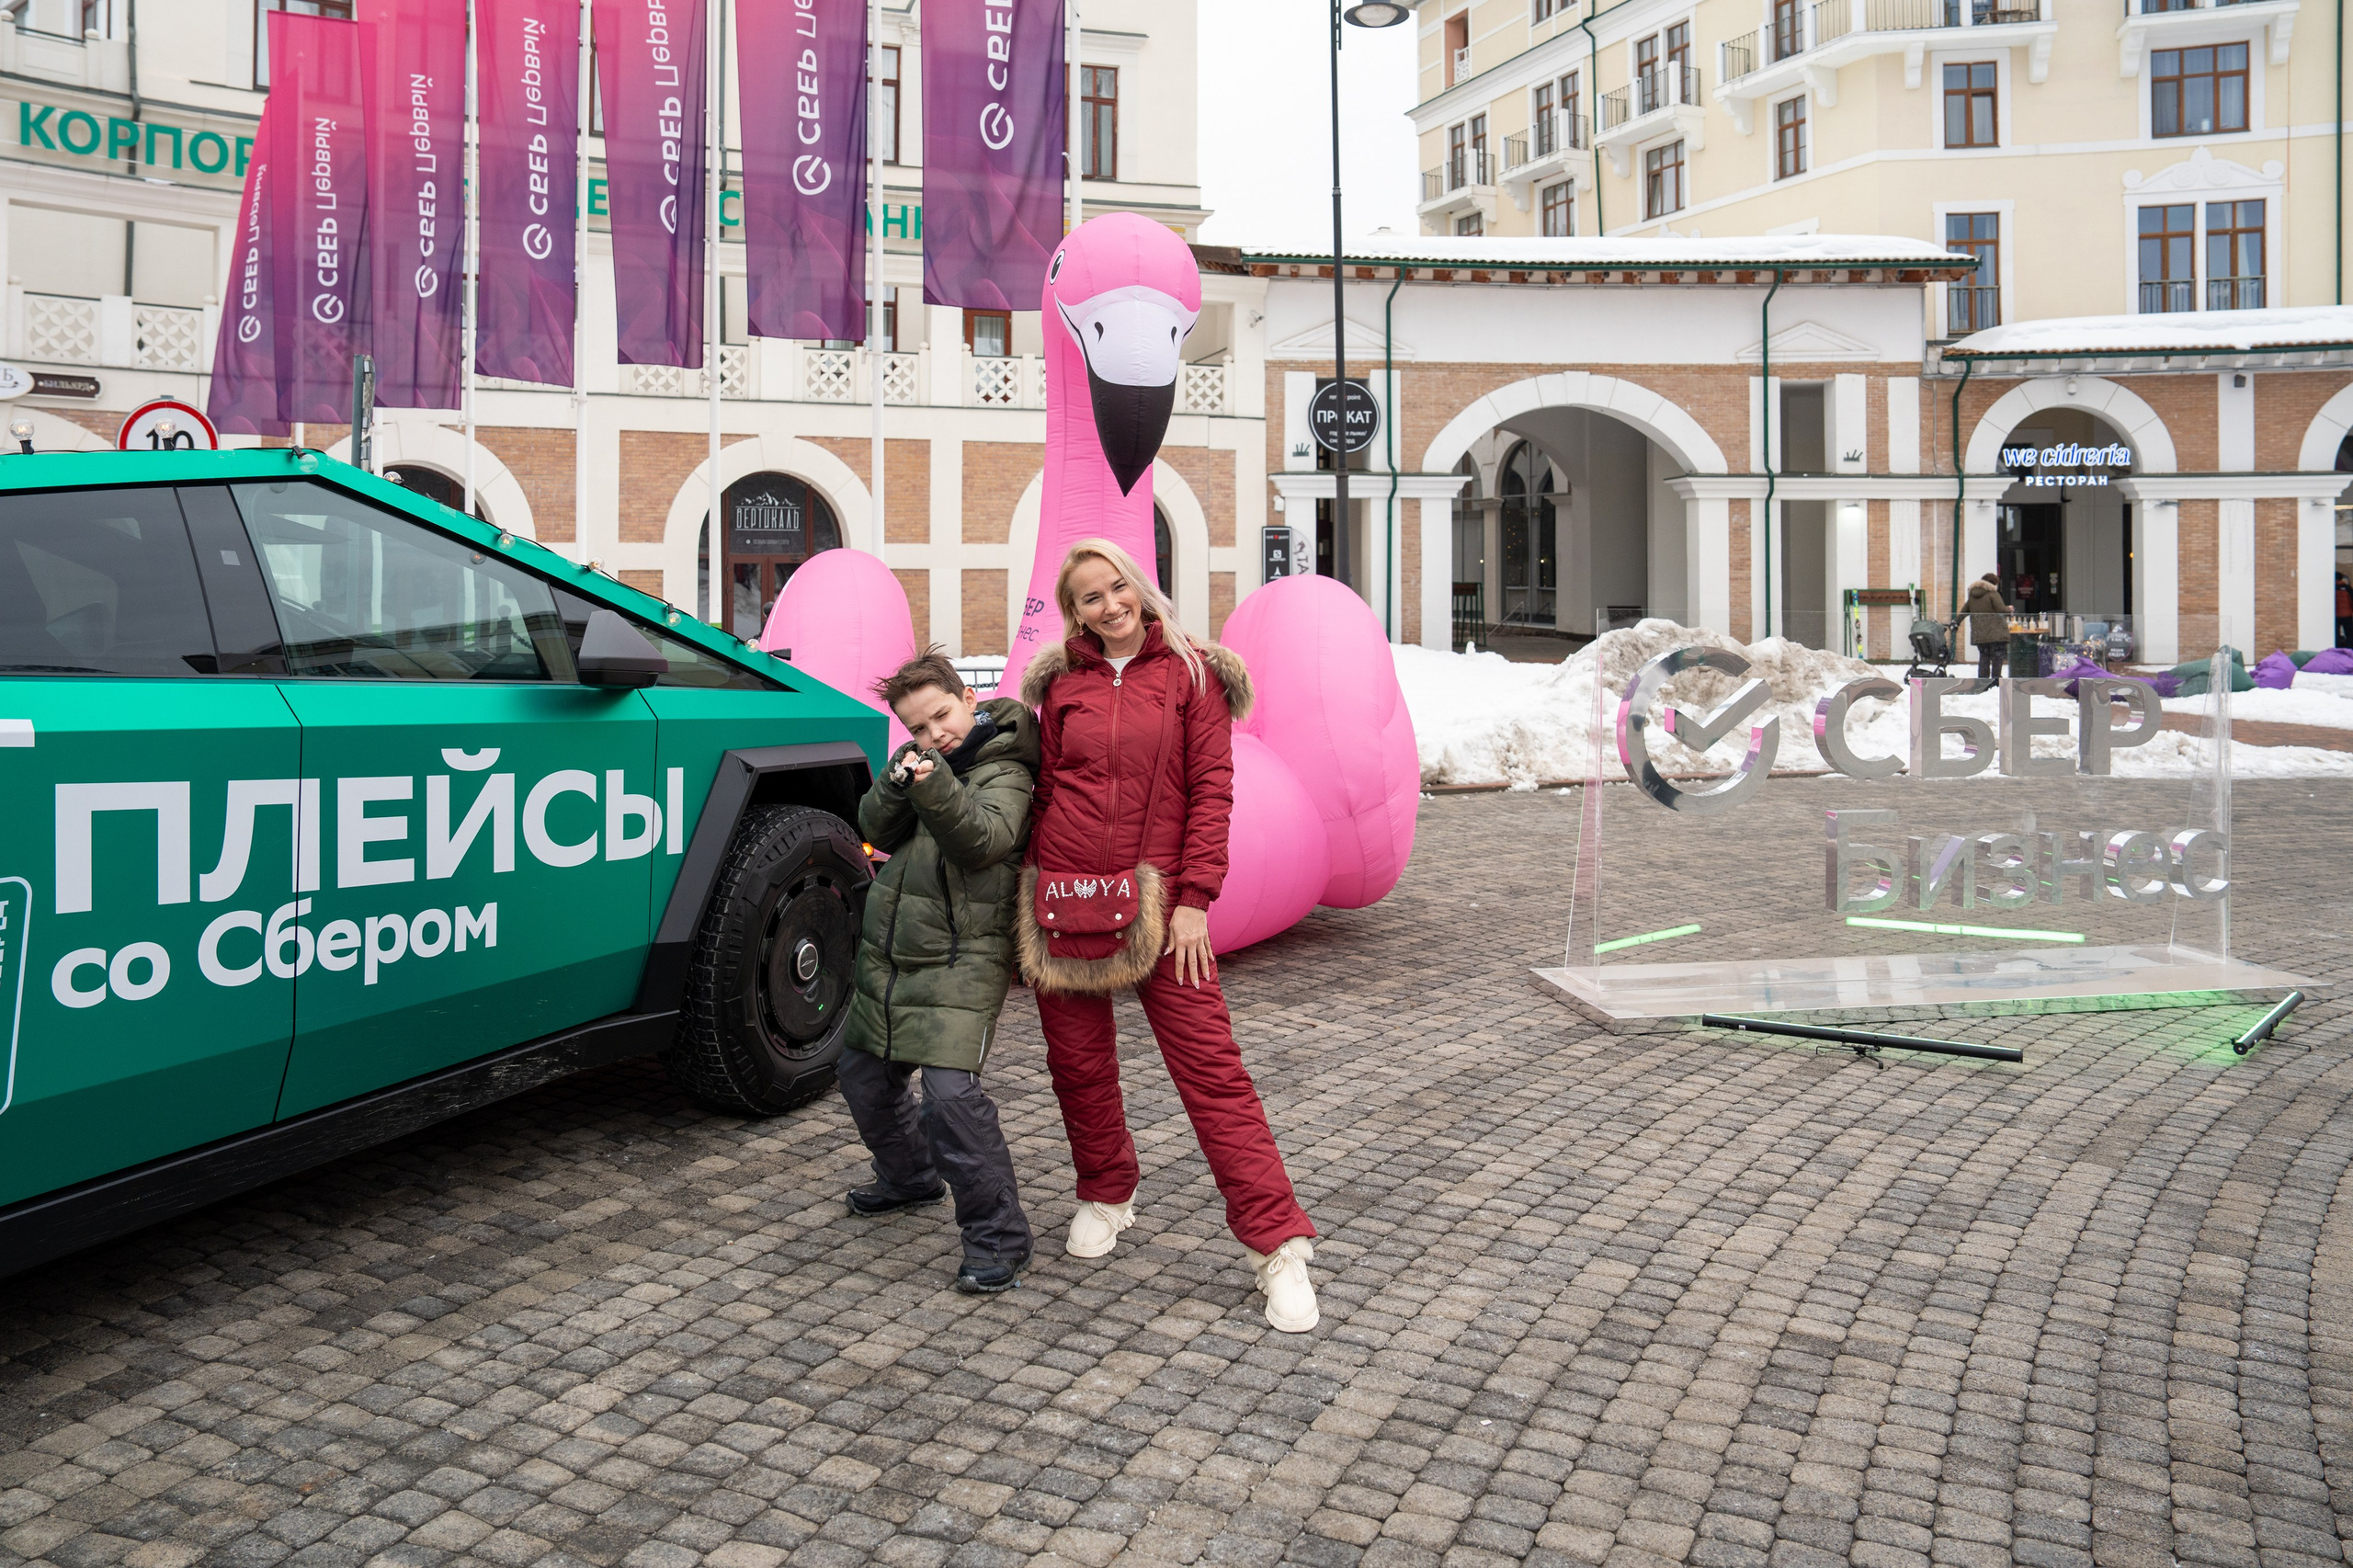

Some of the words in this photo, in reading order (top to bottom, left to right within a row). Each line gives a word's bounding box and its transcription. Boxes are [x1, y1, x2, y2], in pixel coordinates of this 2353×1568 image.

[1316, 410, 1372, 424] ПРКАТ
[2003, 448, 2038, 467] we
[2040, 442, 2131, 467] cidreria
[2025, 475, 2109, 487] РЕСТОРАН
[736, 507, 800, 529] ВЕРТИКАЛЬ
[1813, 676, 2163, 779] СБЕР
[55, 748, 684, 915] ПЛЕЙСЫ
[1825, 810, 2230, 913] Бизнес
[51, 941, 171, 1008] со
[198, 897, 497, 986] Сбером
